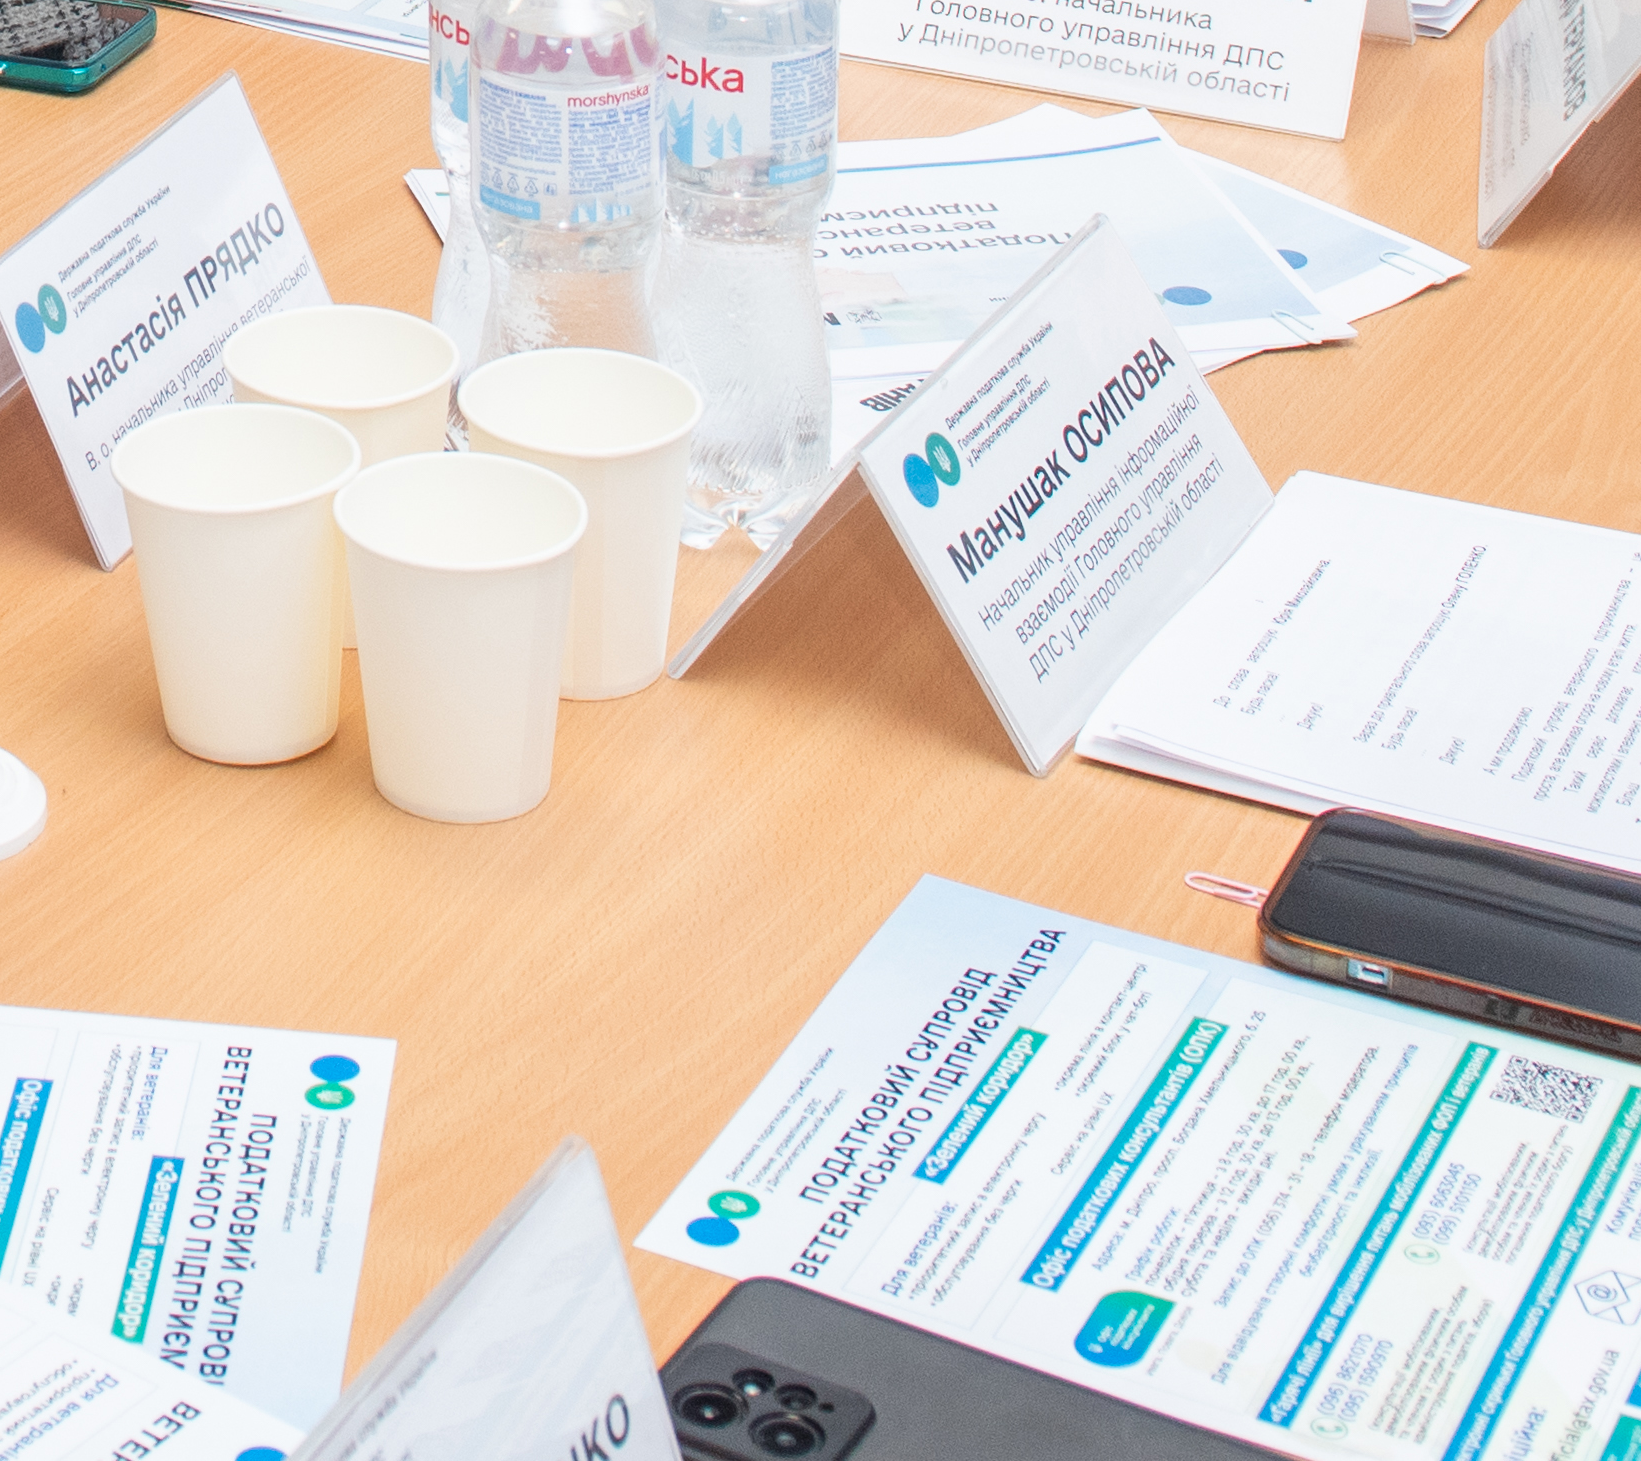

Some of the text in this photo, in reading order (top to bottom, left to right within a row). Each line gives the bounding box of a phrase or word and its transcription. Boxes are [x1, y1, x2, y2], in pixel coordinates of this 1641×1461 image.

[566, 84, 650, 108] morshynska
[896, 22, 1291, 102] у Дніпропетровській області
[1061, 20, 1216, 60] управління
[1222, 43, 1285, 72] ДПС
[66, 202, 285, 418] Анастасія ПРЯДКО
[946, 337, 1176, 584] Манушак ОСИПОВА
[977, 390, 1200, 632] Начальник управління інформаційної
[1014, 432, 1204, 645] взаємодії Головного управління
[1028, 456, 1224, 685] ДПС у Дніпропетровській області
[190, 1045, 252, 1230] ВЕТЕРАНСЬКОГО
[790, 928, 1067, 1278] ВЕТЕРАНСЬКОГО ПІДПРИЄМНИЦТВА
[799, 966, 998, 1203] ПОДАТКОВИЙ СУПРОВІД
[924, 1032, 1035, 1177] «Зелений коридор»
[1029, 1020, 1225, 1289] Офіс податкових консультантів (ОПК)
[220, 1112, 278, 1272] ПОДАТКОВИЙ
